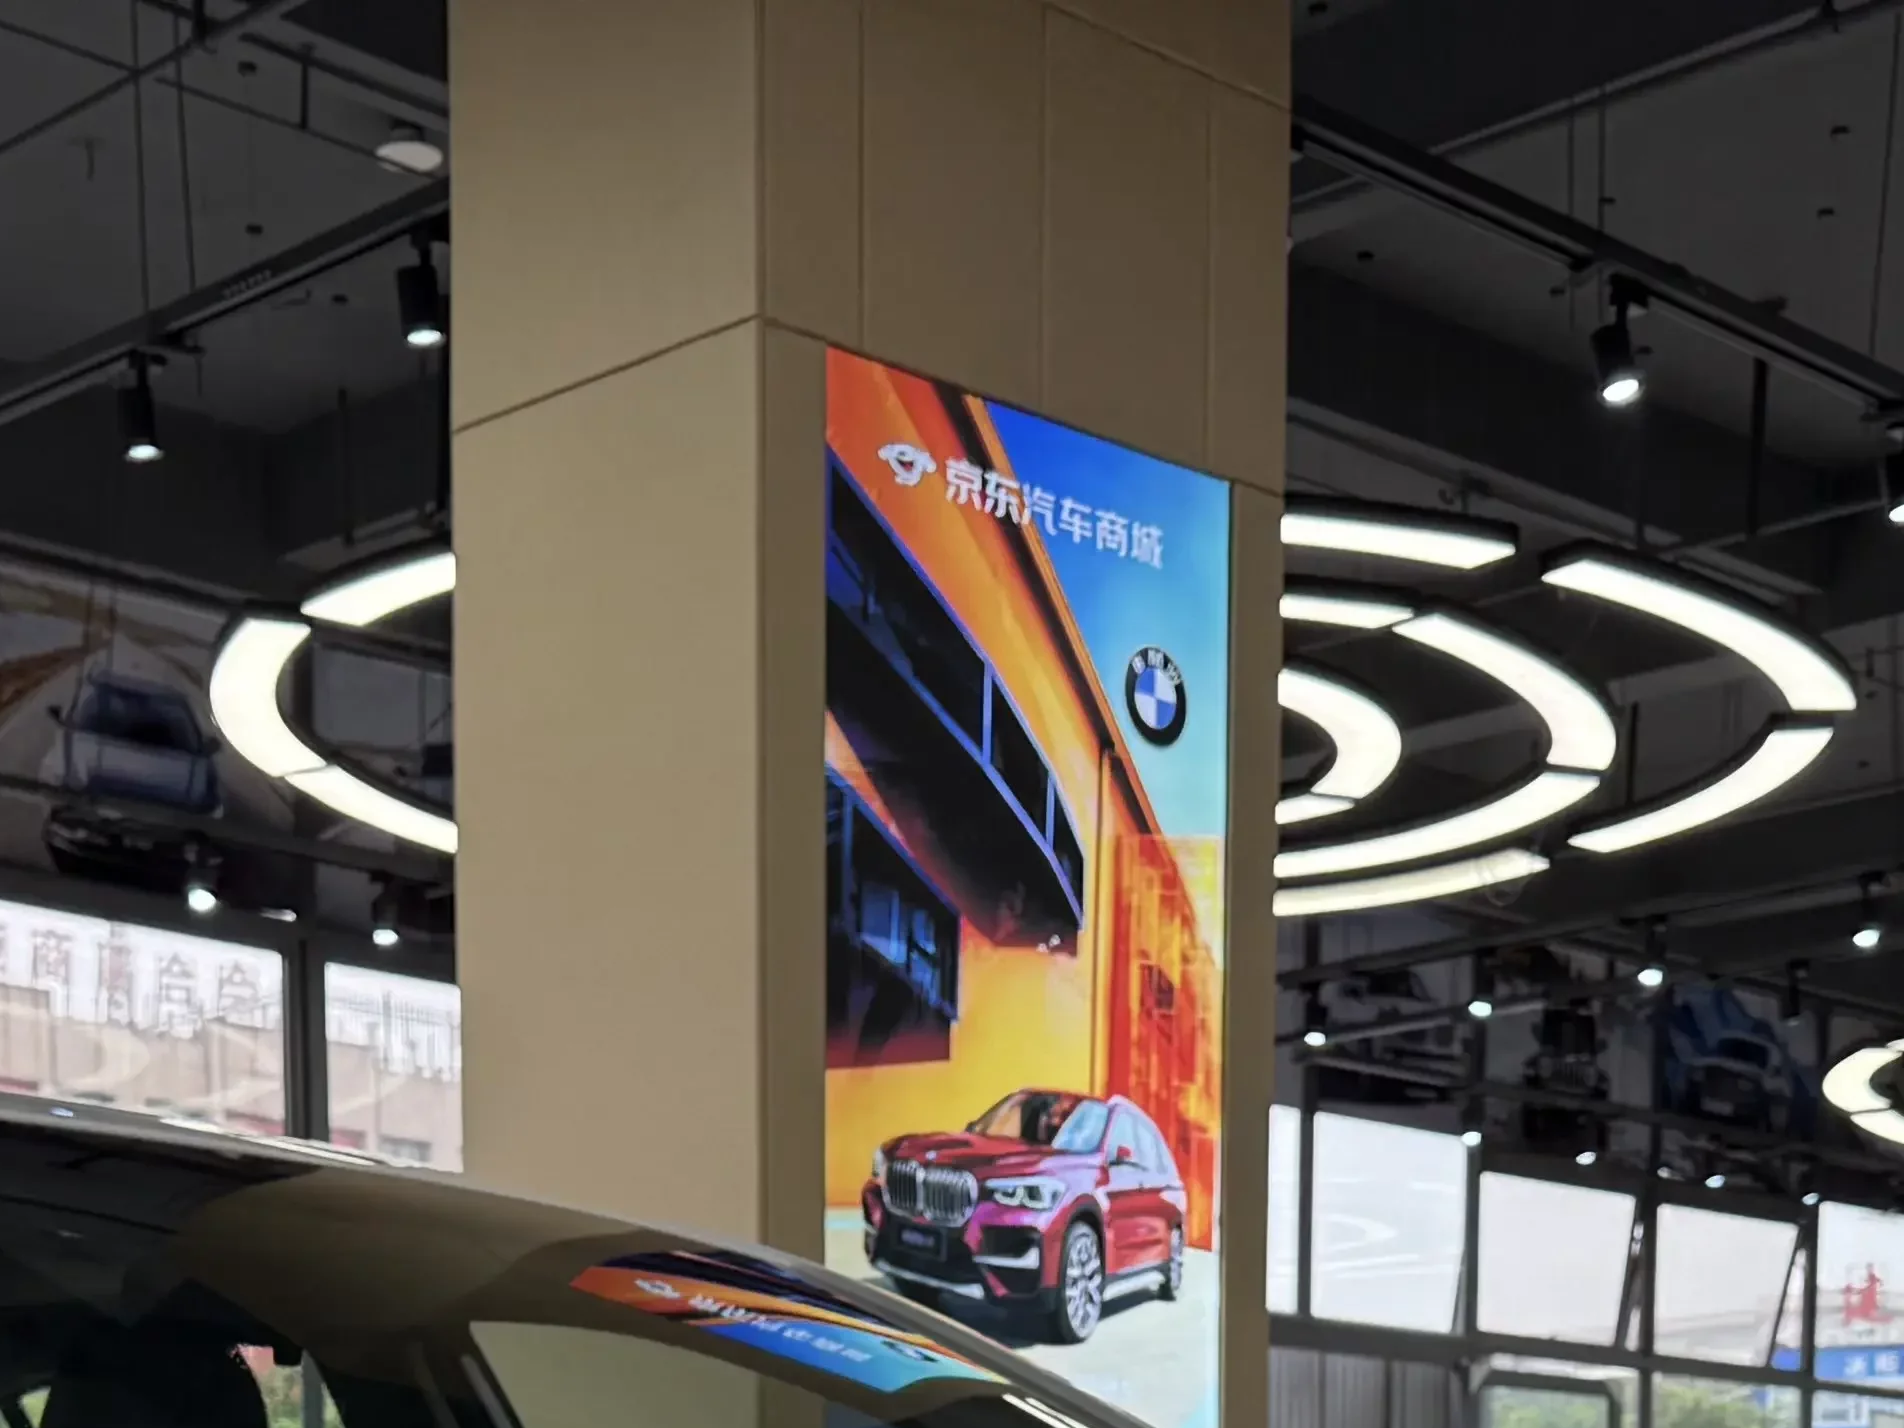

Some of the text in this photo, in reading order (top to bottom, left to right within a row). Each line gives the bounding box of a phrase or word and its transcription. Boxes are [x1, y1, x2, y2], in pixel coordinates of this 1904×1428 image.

[945, 456, 1164, 570] 京东汽车商城
